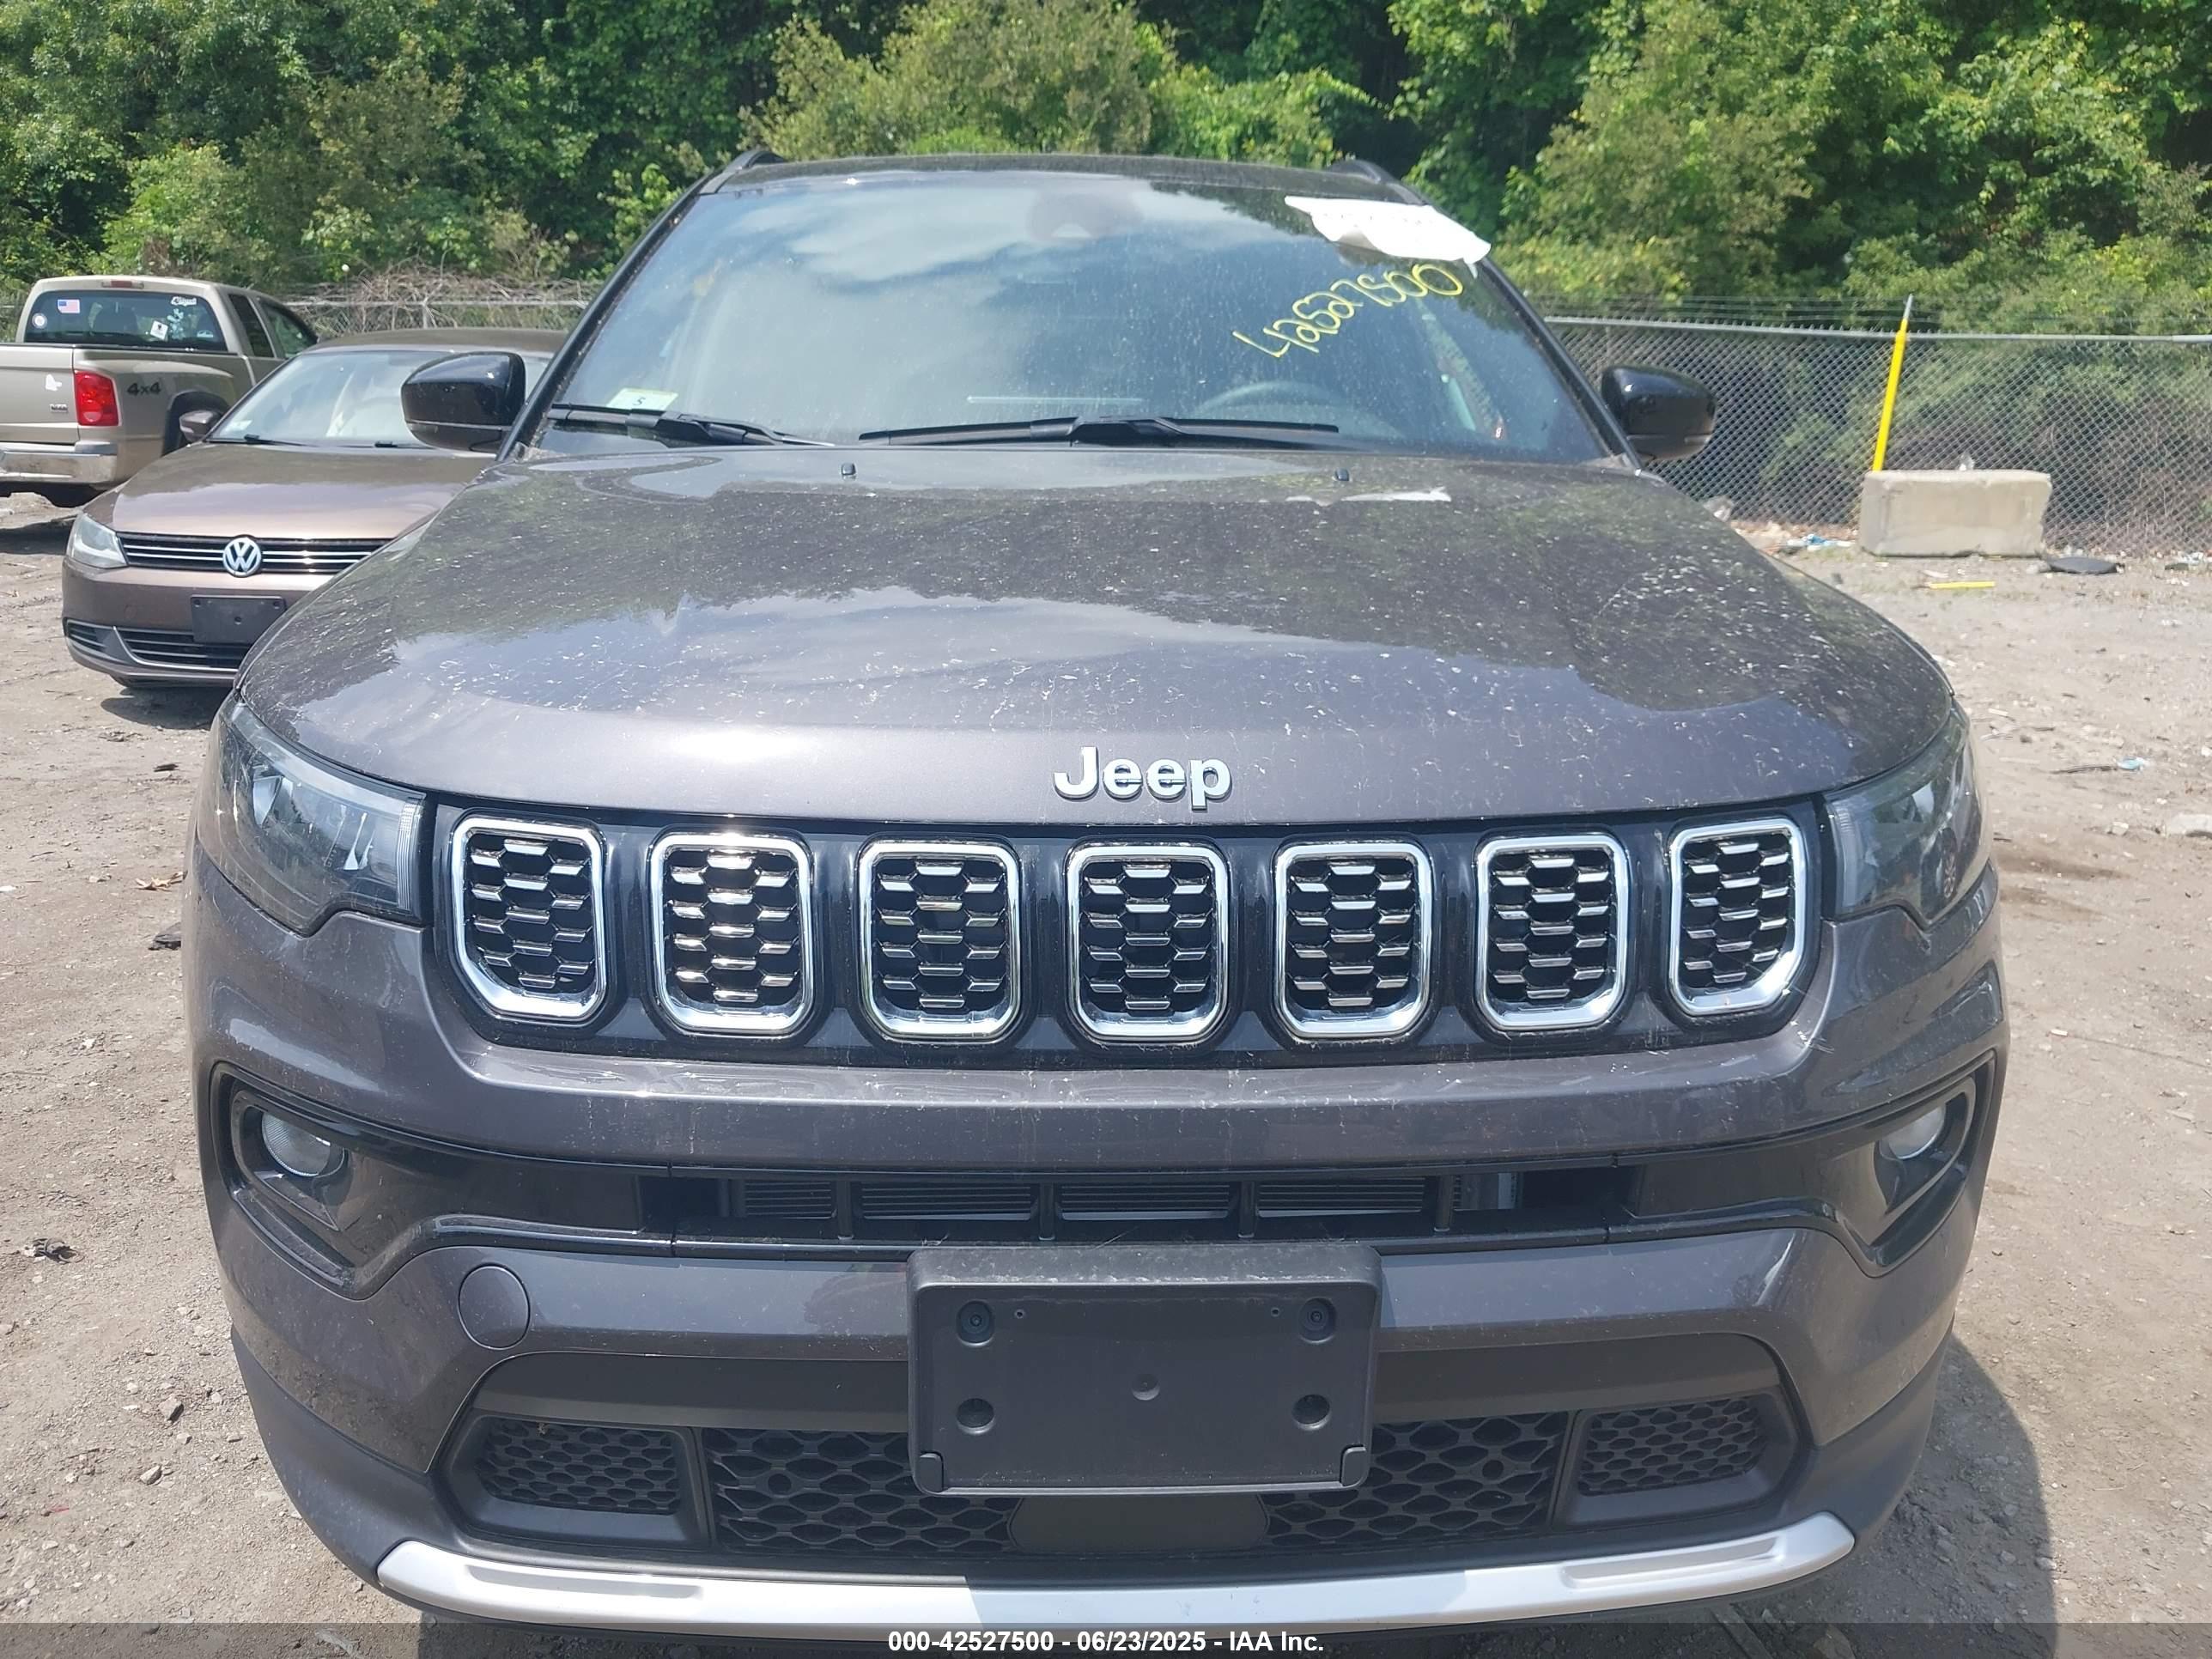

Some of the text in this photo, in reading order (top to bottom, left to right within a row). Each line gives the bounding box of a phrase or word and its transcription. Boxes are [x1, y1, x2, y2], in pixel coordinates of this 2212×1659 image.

[1231, 263, 1464, 358] 42527500
[127, 382, 161, 396] 4x4
[223, 537, 261, 575] VW
[1054, 746, 1232, 811] Jeep
